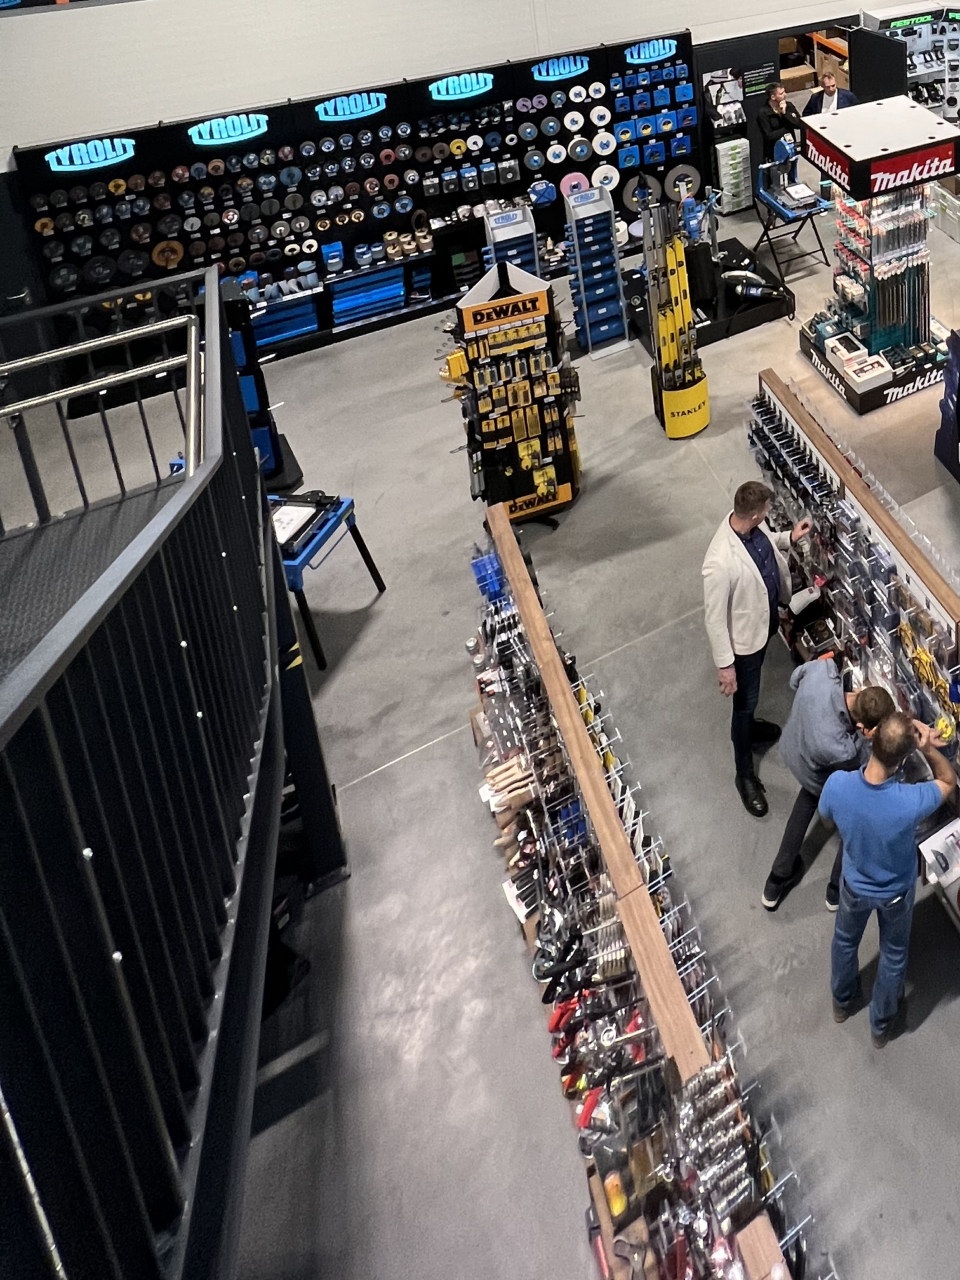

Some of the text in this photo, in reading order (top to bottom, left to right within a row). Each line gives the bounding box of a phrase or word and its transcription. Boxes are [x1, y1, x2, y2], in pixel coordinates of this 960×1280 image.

[890, 15, 934, 28] FESTOOL
[624, 38, 678, 65] TYROLIT
[531, 55, 590, 82] TYROLIT
[428, 72, 494, 101] TYROLIT
[314, 92, 388, 122] TYROLIT
[187, 114, 269, 146] TYROLIT
[44, 137, 136, 172] TYROLIT
[670, 400, 706, 418] STANLEY
